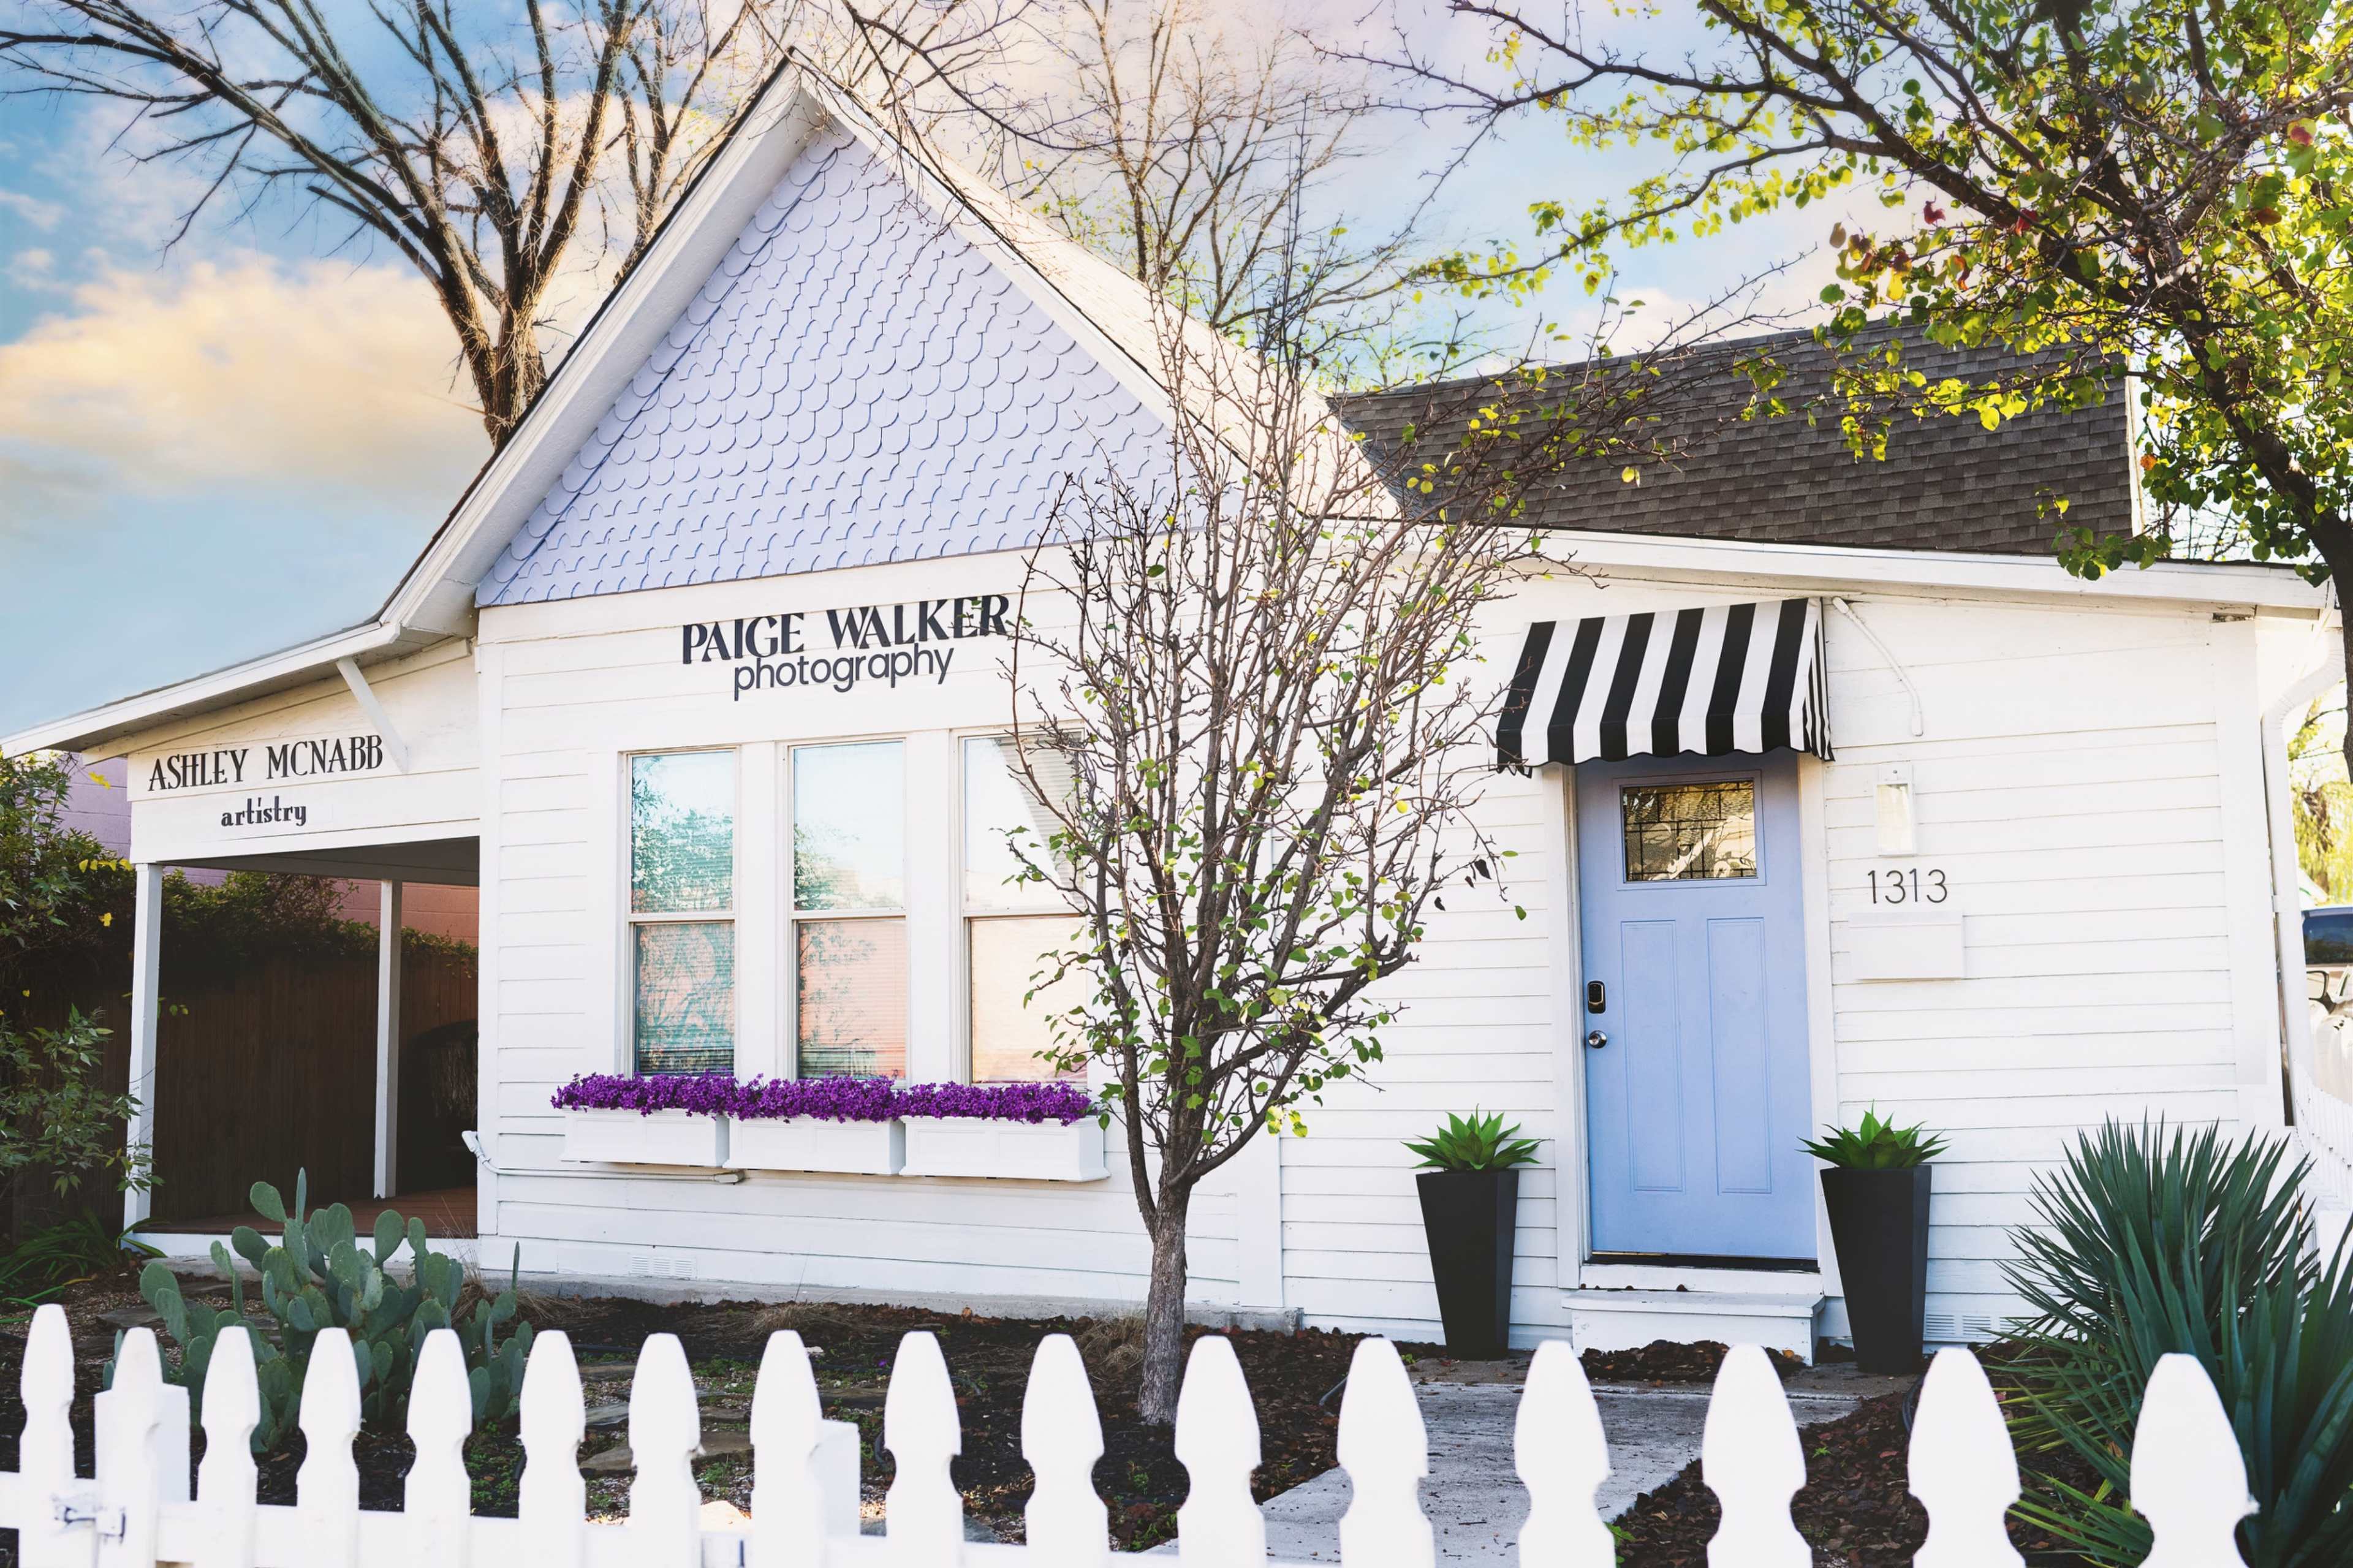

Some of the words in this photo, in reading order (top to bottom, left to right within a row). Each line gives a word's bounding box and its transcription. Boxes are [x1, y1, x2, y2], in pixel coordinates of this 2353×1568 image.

[683, 613, 805, 664] PAIGE
[826, 594, 1011, 650] WALKER
[734, 643, 954, 700] photography
[148, 749, 249, 792] ASHLEY
[265, 735, 383, 779] MCNABB
[221, 795, 307, 826] artistry
[1867, 868, 1947, 904] 1313
